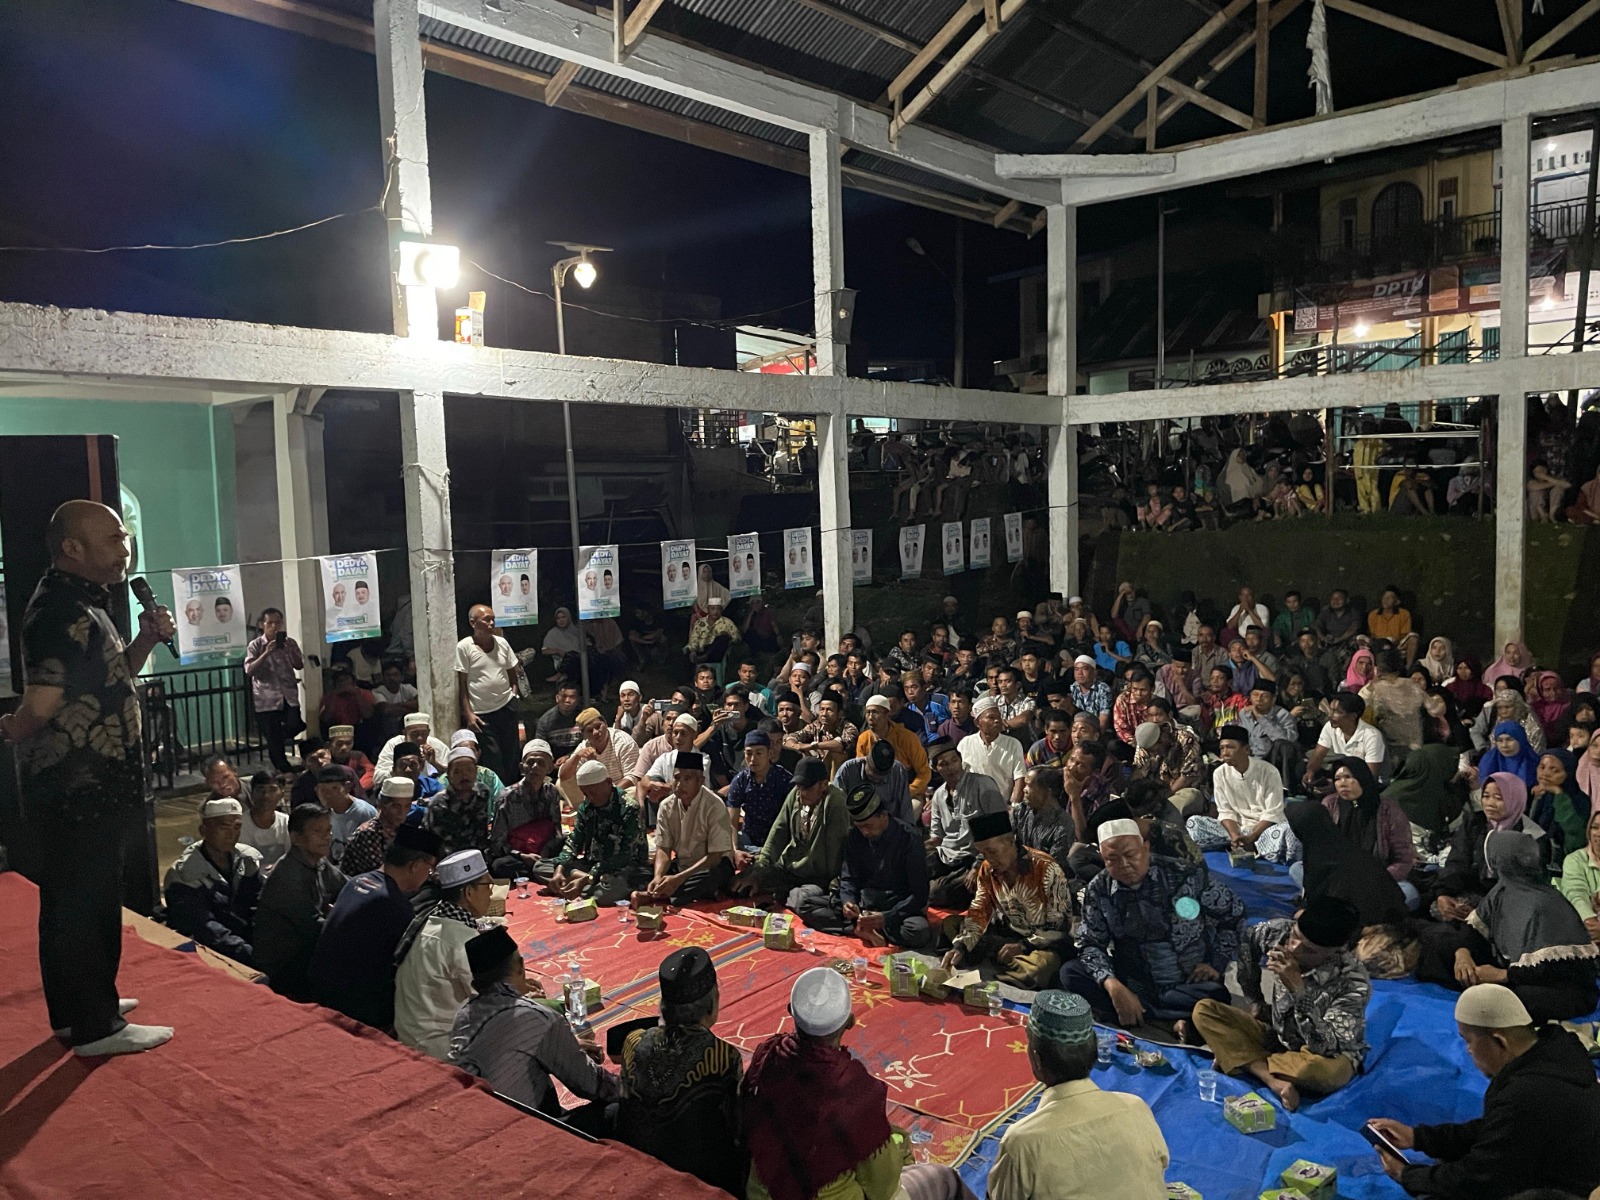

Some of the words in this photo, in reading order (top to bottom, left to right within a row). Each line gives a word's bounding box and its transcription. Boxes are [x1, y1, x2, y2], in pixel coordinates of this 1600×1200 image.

[505, 560, 529, 570] DAYAT
[590, 557, 612, 565] DAYAT
[337, 566, 368, 577] DAYAT
[192, 580, 230, 592] DAYAT
